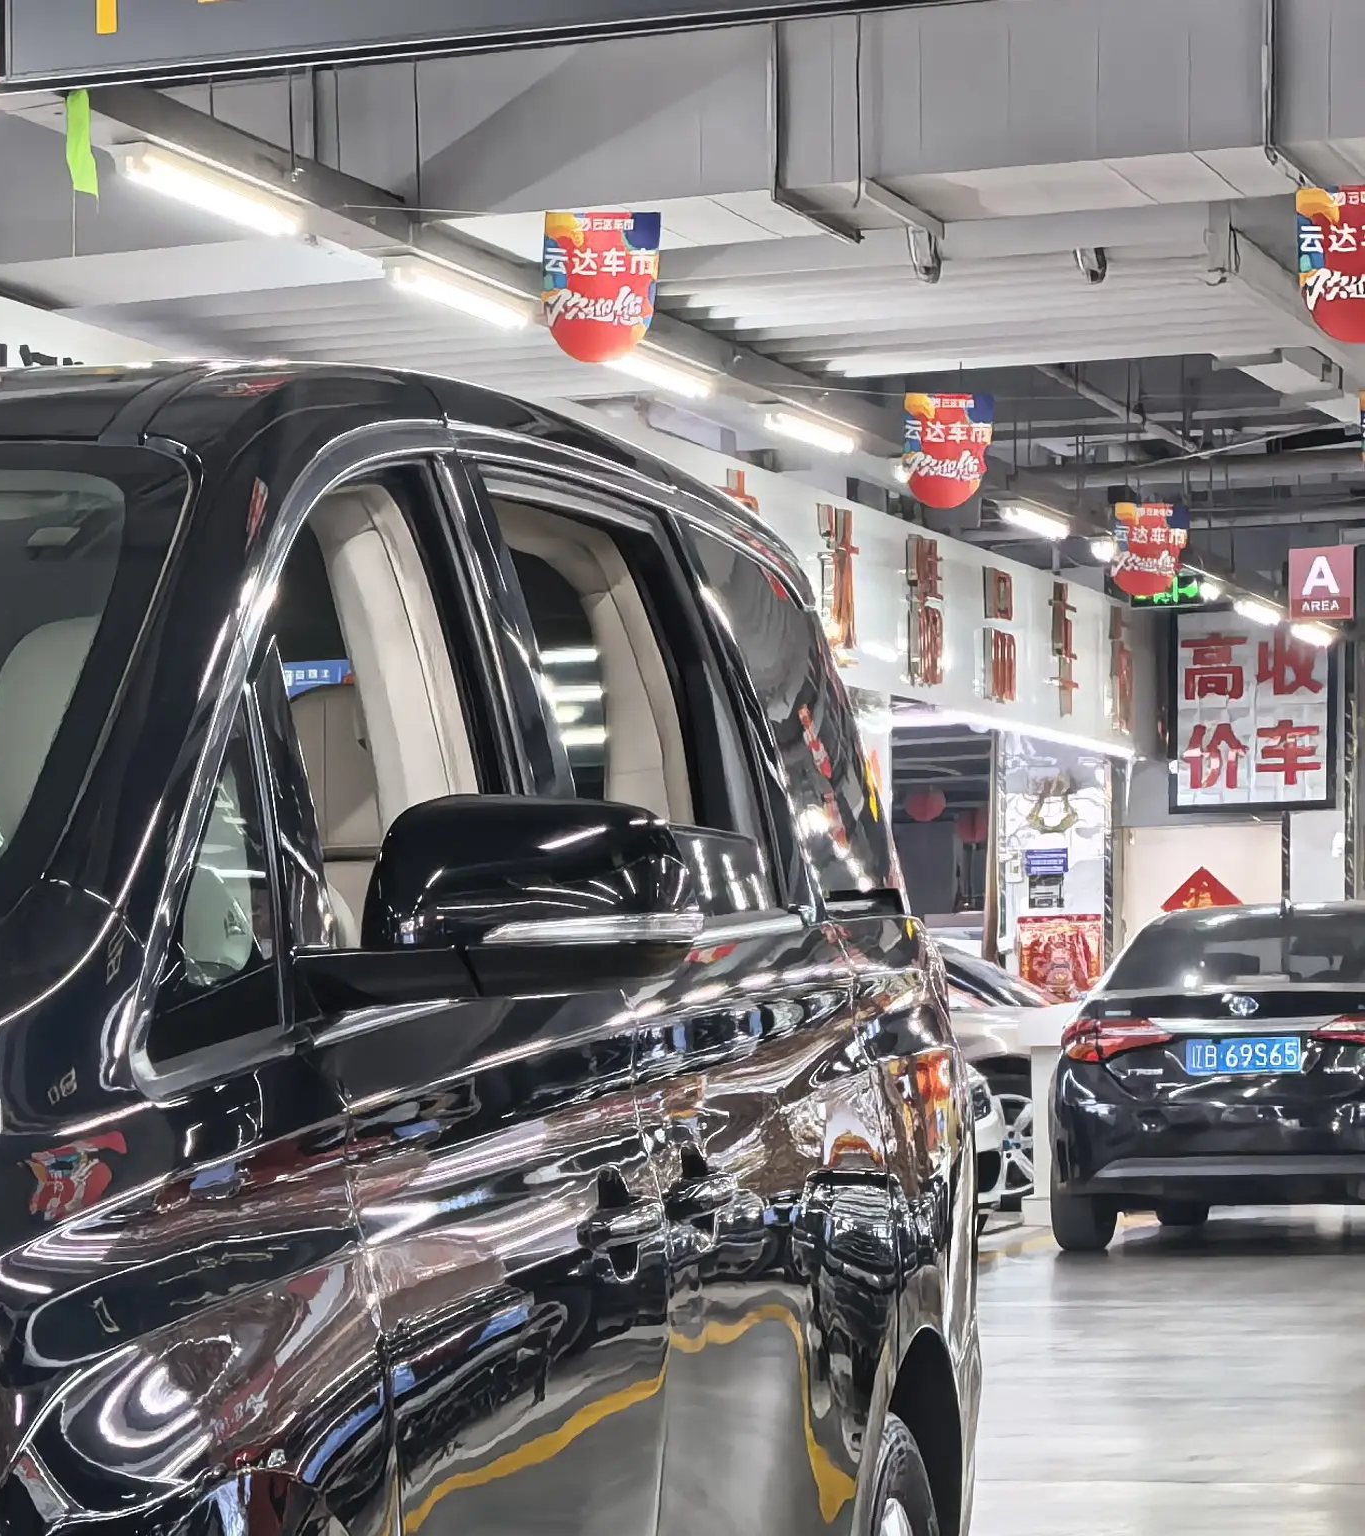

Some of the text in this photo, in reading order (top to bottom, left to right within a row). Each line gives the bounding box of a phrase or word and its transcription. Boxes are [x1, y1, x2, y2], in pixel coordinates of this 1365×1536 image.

[1299, 223, 1365, 253] 云达
[544, 247, 657, 277] 云达车市
[904, 419, 992, 445] 云达车市
[1301, 555, 1340, 595] A
[1301, 599, 1340, 612] AREA
